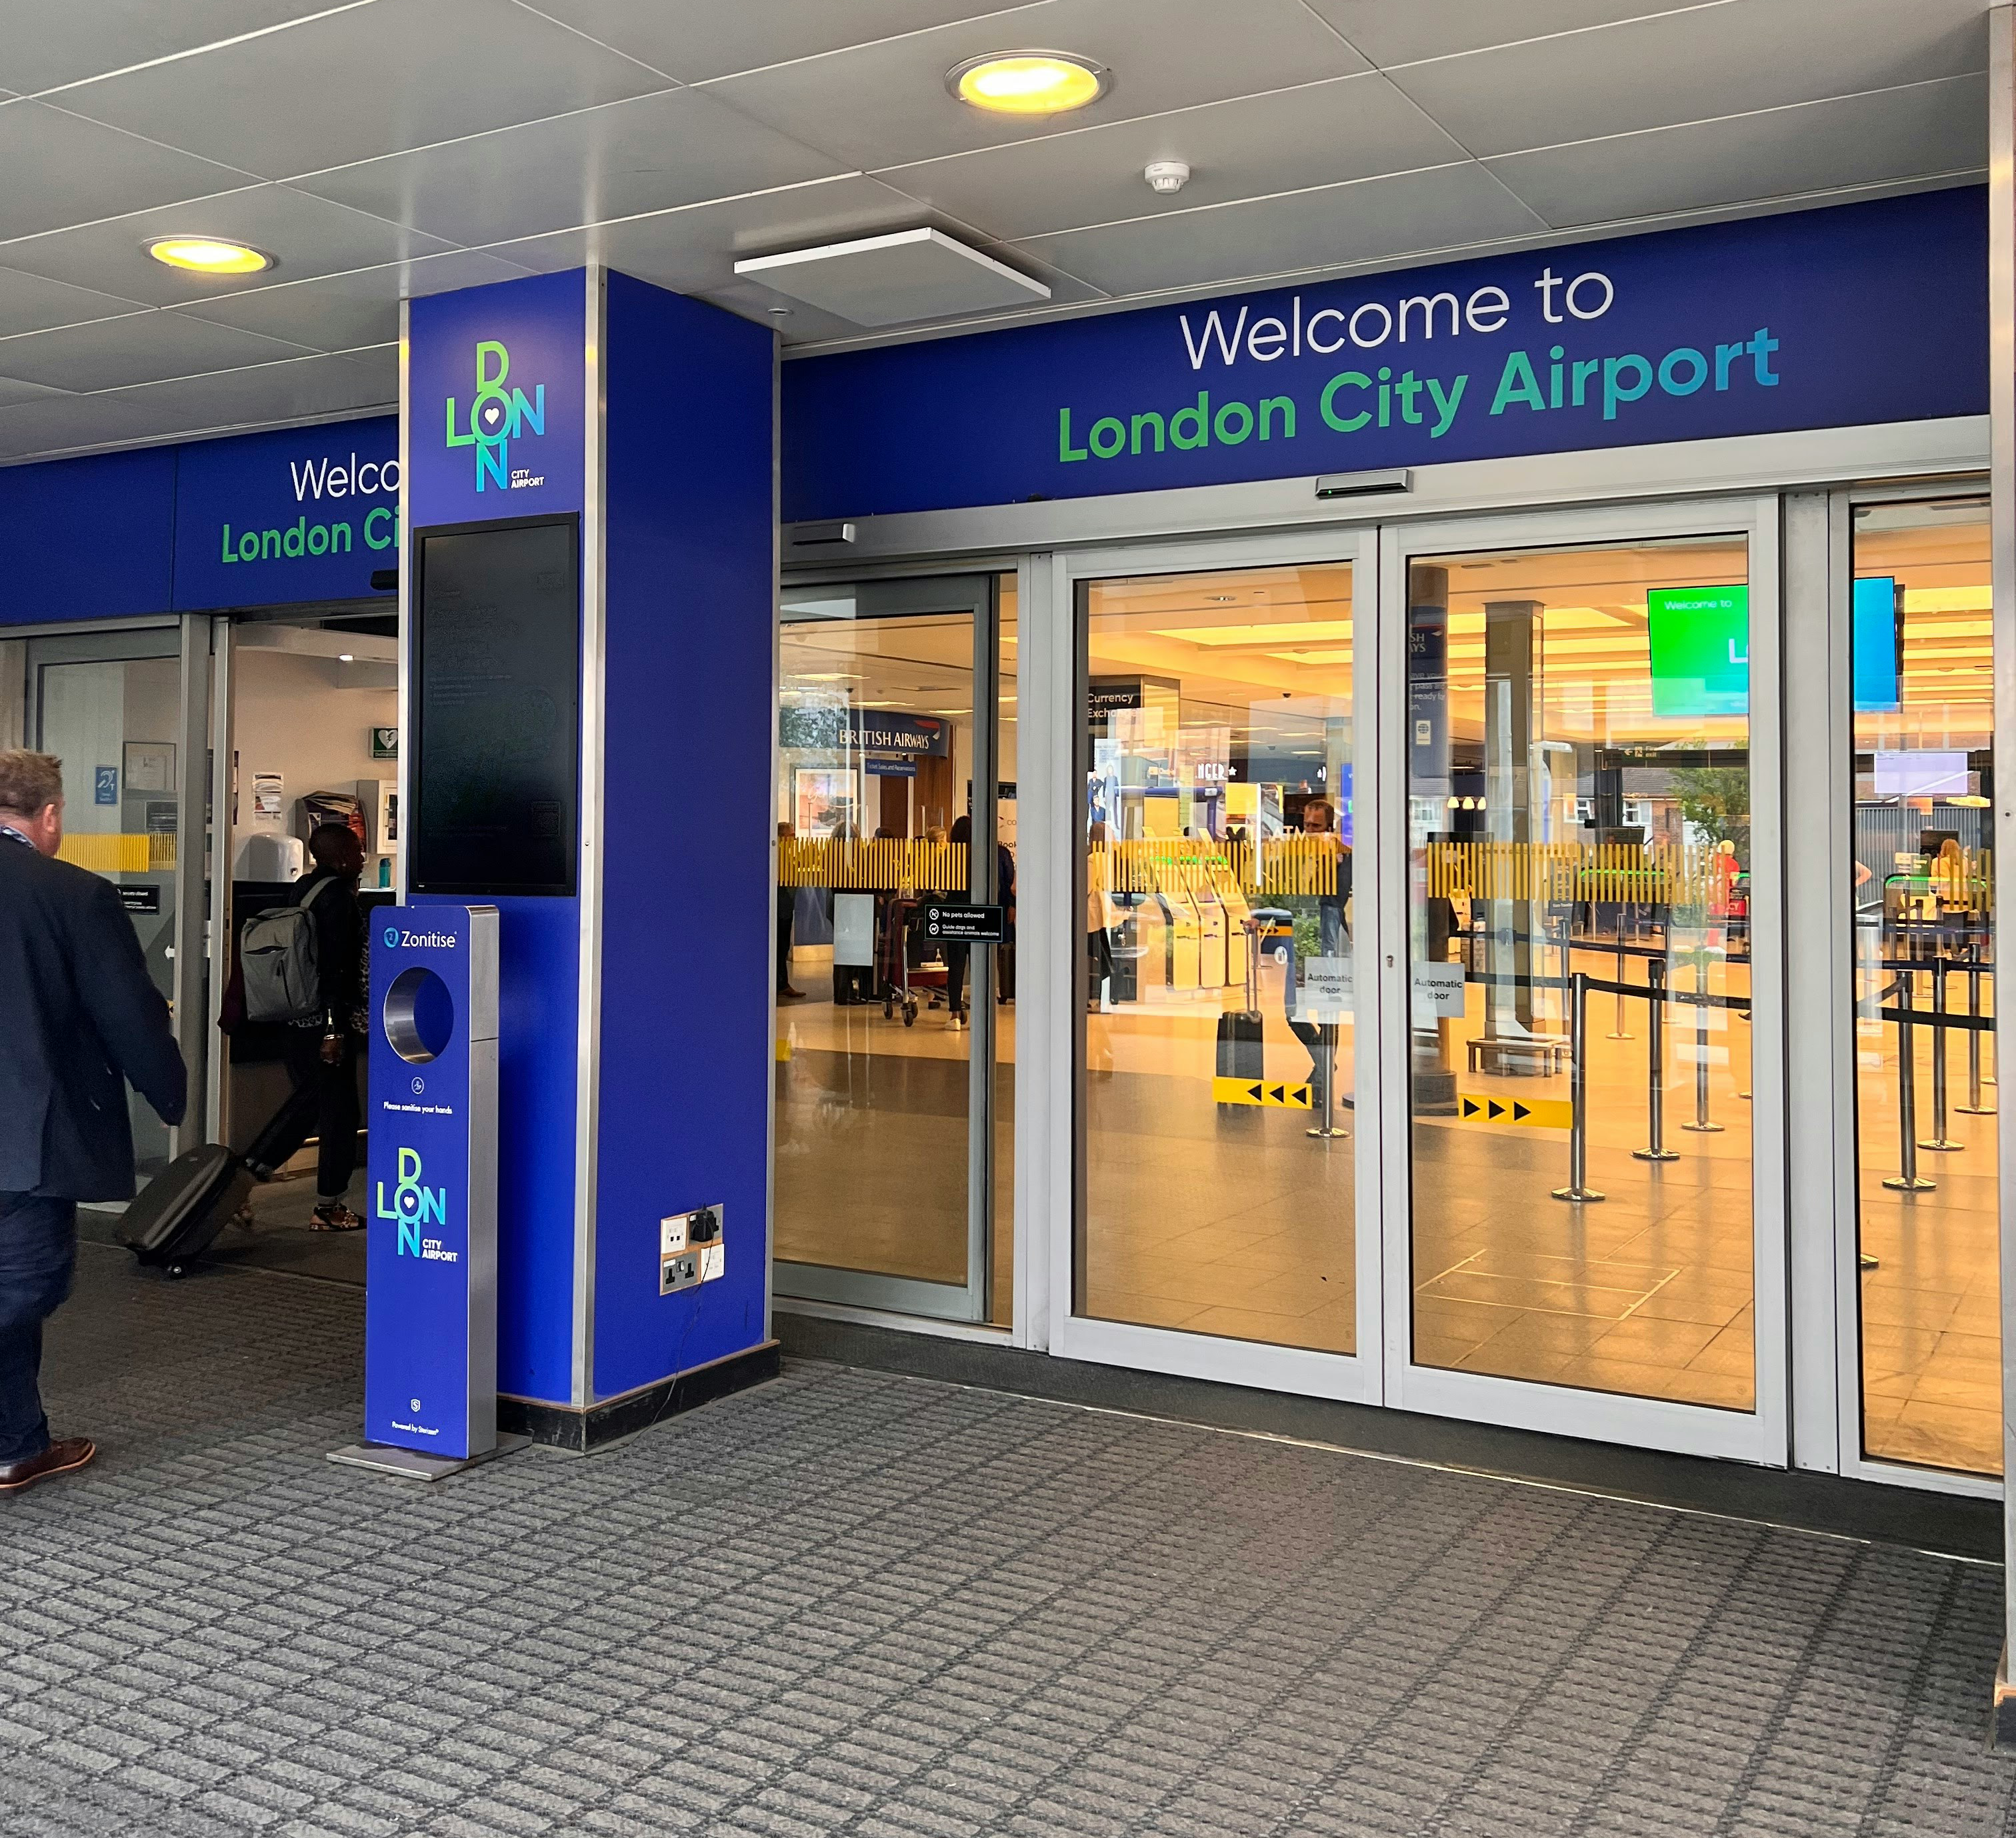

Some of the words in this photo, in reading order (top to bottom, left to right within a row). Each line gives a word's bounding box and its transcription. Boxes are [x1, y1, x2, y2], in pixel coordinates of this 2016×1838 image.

[1179, 286, 1510, 370] Welcome
[1534, 267, 1614, 323] to
[1059, 391, 1295, 463] London
[1320, 367, 1469, 439] City
[1489, 327, 1779, 420] Airport
[290, 452, 399, 501] Welco
[511, 469, 530, 479] CITY
[511, 476, 545, 489] AIRPORT
[221, 516, 351, 563] London
[364, 505, 399, 550] Ci
[1664, 601, 1717, 610] Welcome
[1729, 638, 1748, 663] L
[1087, 693, 1134, 704] Currency
[839, 729, 891, 746] BRITISH
[893, 732, 929, 749] AIRWAYS
[1271, 825, 1309, 841] ATM
[401, 931, 456, 948] Zonitise
[1307, 973, 1353, 983] Automatic
[1414, 978, 1463, 989] Automatic
[1319, 985, 1341, 994] door
[1427, 991, 1450, 1000] door
[383, 1101, 401, 1110] Please
[401, 1104, 421, 1112] sanitise
[435, 1105, 453, 1114] hands
[422, 1239, 442, 1250] CITY
[421, 1249, 458, 1262] AIRPORT
[391, 1421, 411, 1431] Powered
[411, 1423, 418, 1433] by
